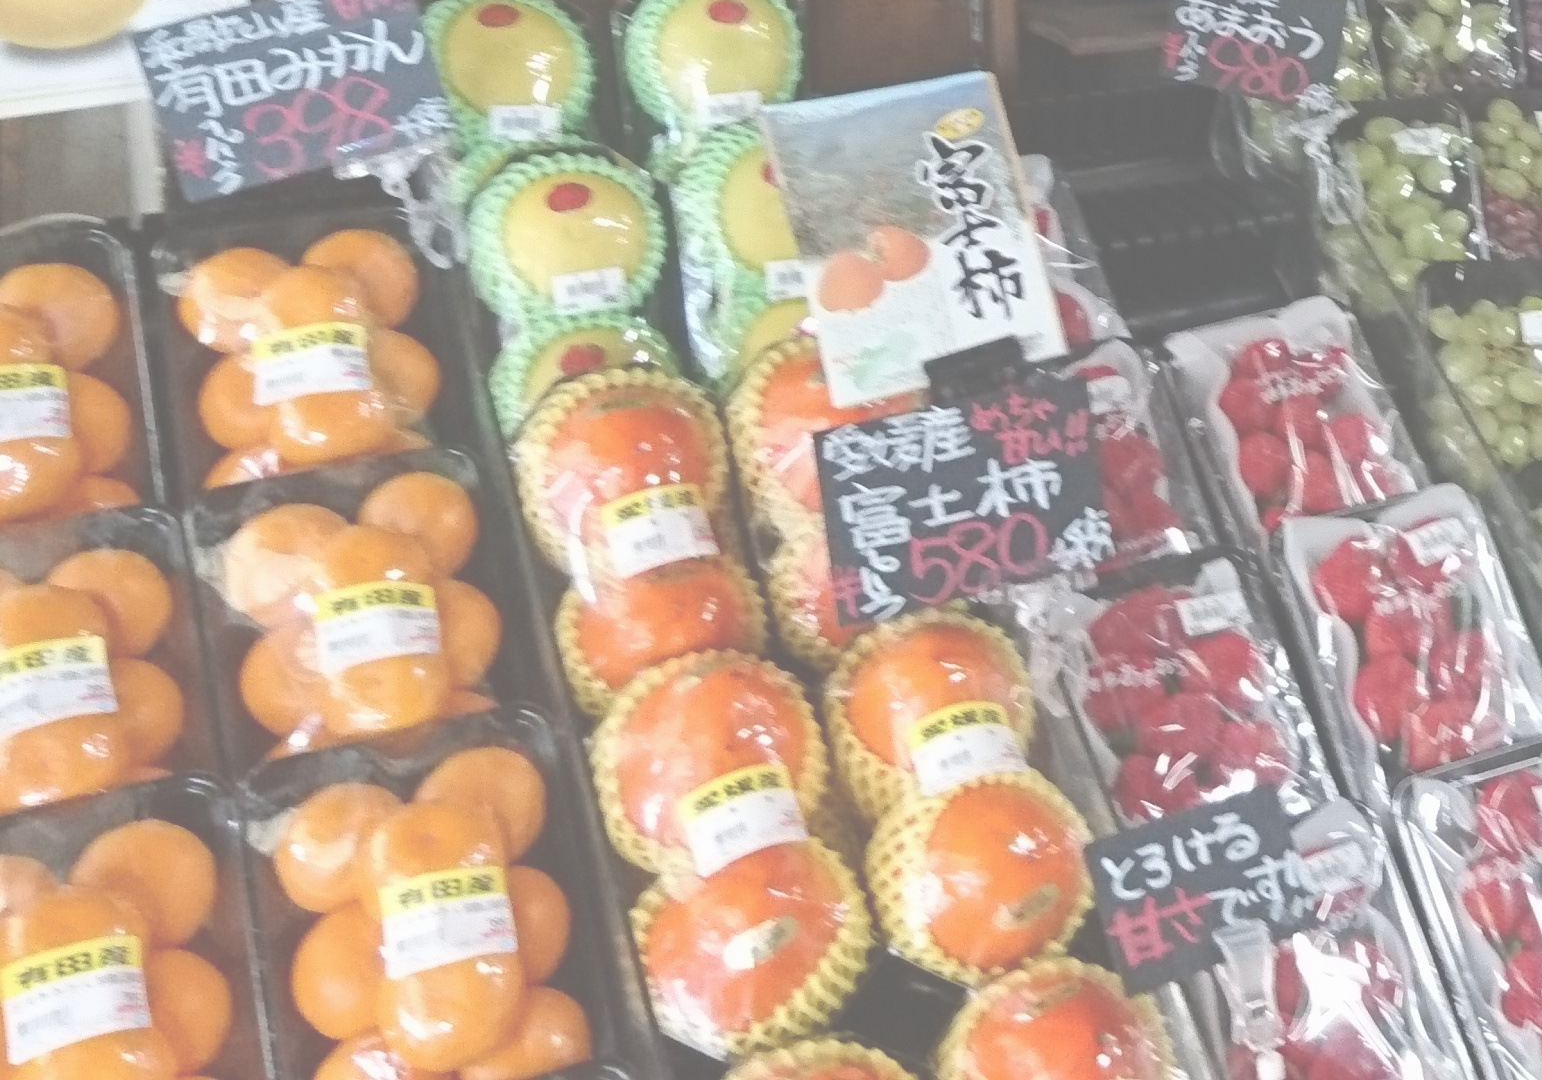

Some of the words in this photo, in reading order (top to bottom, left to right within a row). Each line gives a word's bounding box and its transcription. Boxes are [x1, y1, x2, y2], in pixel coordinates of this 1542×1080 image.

[153, 17, 426, 118] 有田みかん
[243, 74, 391, 180] 398
[837, 457, 1064, 558] 富士柿
[907, 511, 1051, 606] 580
[1100, 811, 1261, 901] とろける
